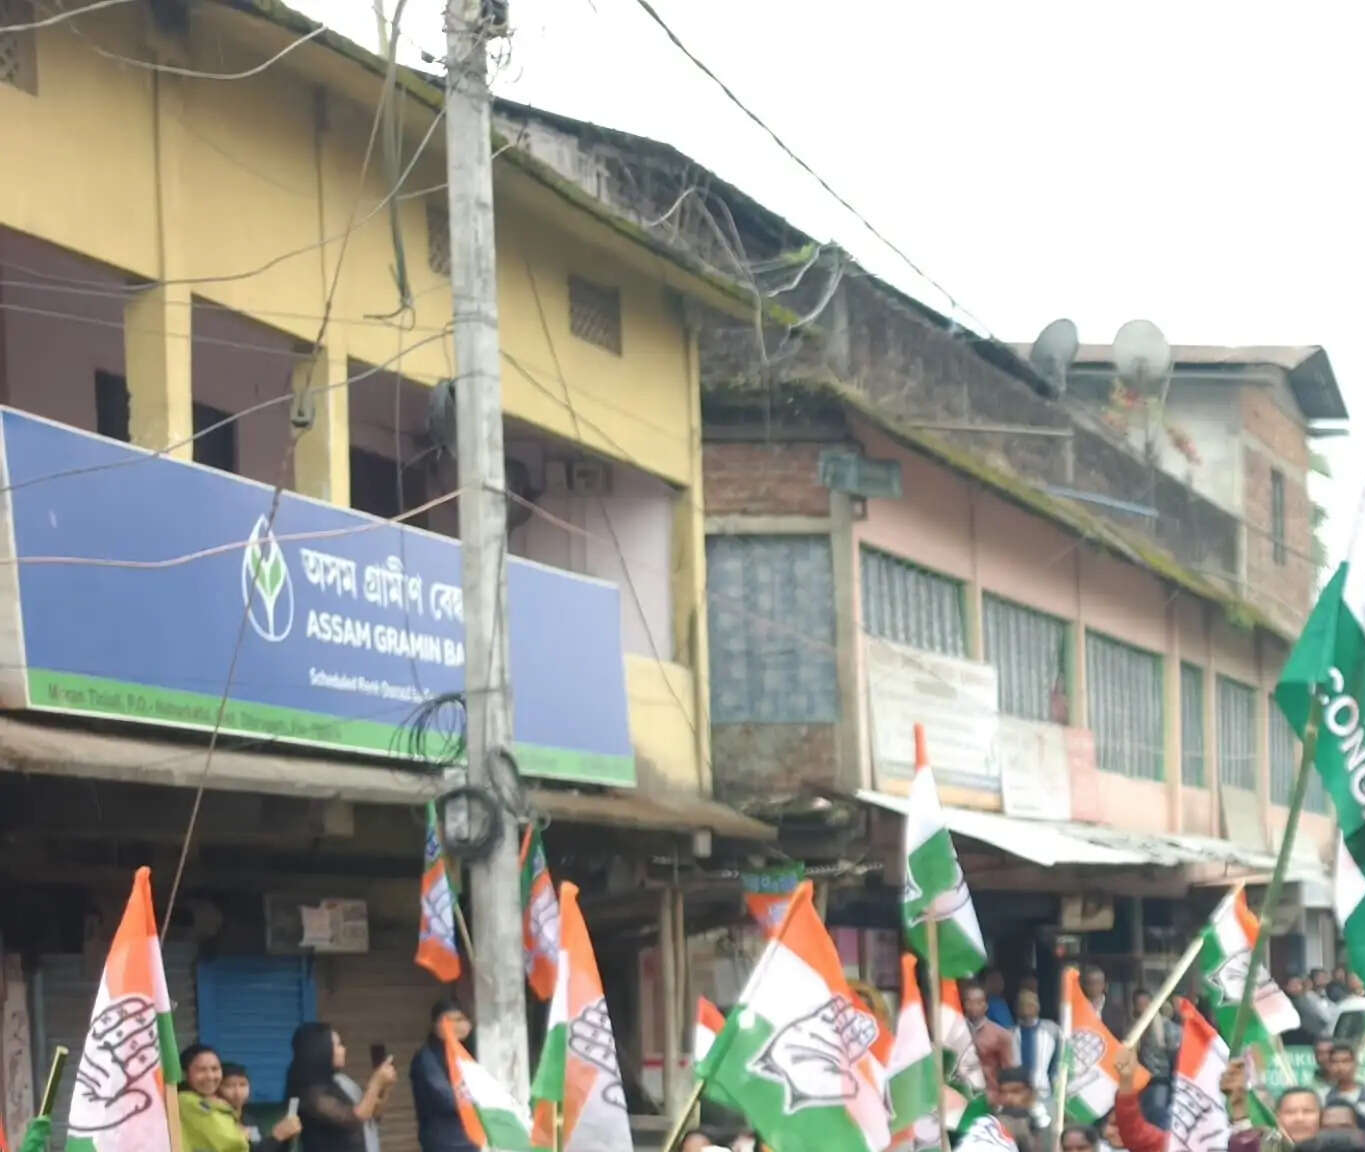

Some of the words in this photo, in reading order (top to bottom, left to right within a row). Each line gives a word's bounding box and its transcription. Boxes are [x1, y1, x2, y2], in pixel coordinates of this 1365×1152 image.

[306, 609, 372, 650] ASSAM
[373, 625, 442, 665] GRAMIN
[443, 639, 466, 667] BA
